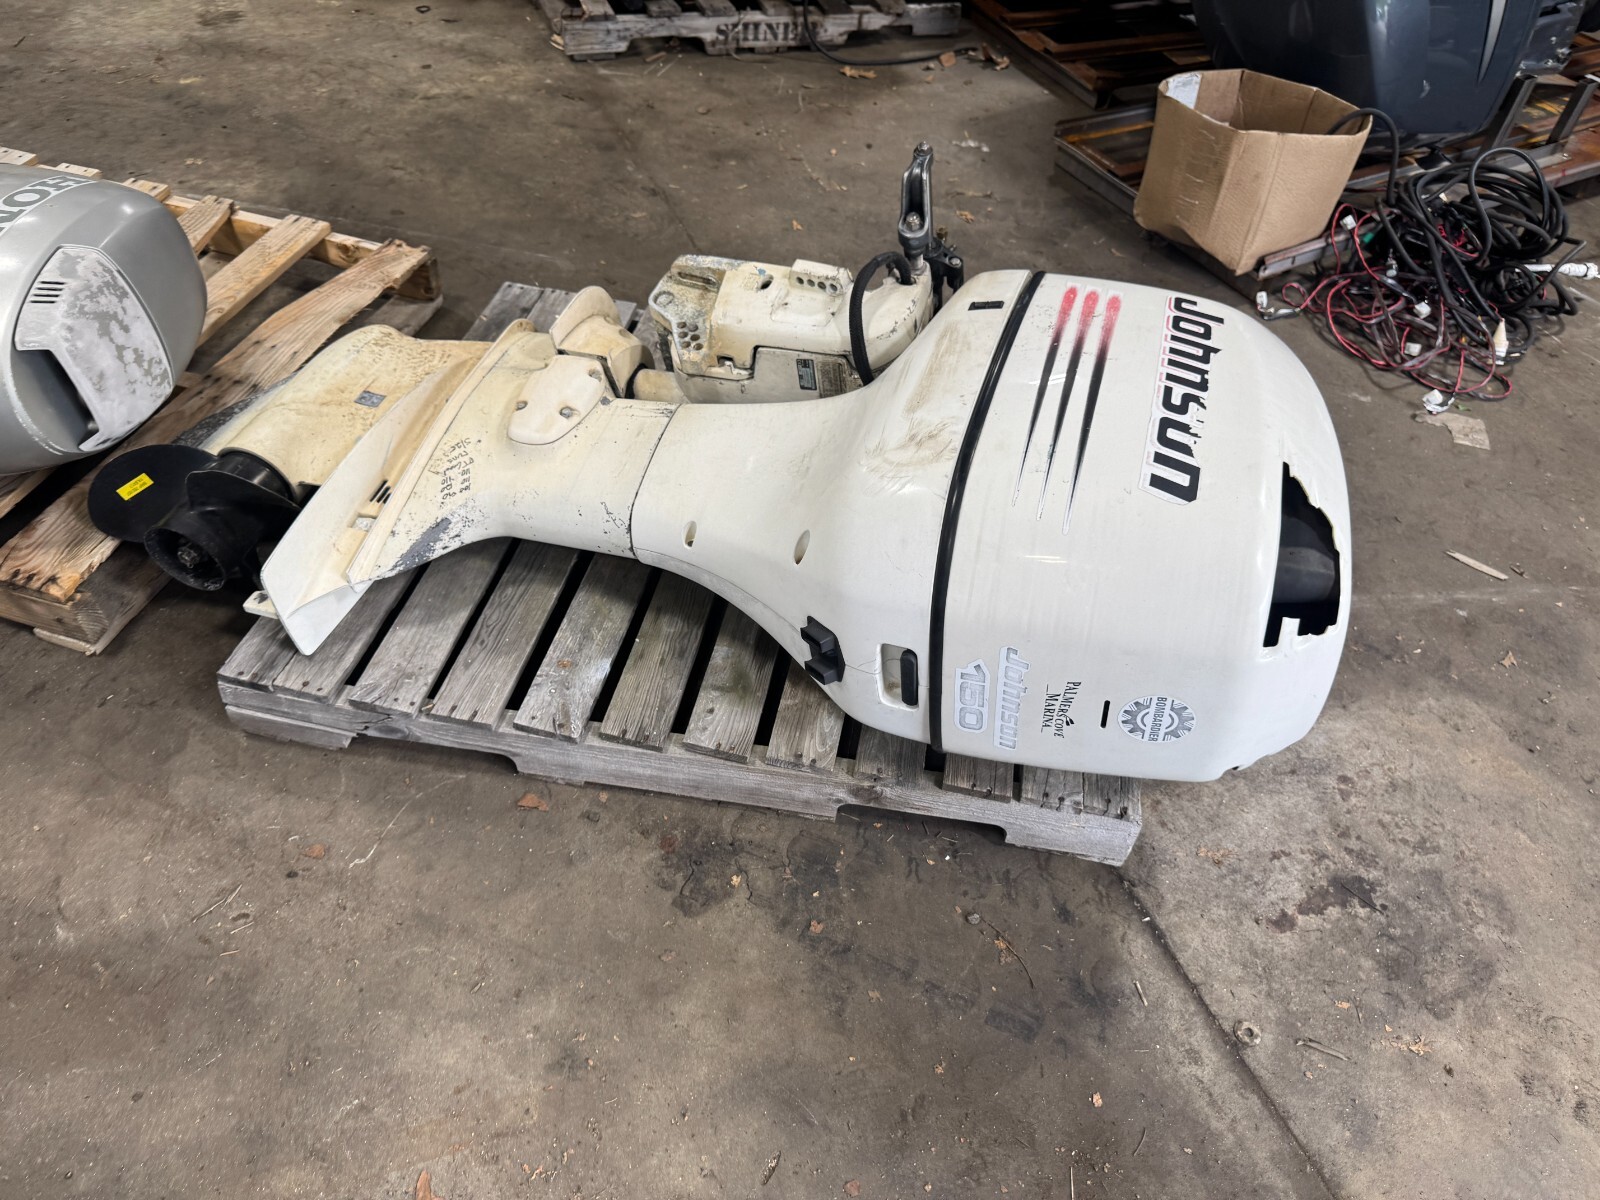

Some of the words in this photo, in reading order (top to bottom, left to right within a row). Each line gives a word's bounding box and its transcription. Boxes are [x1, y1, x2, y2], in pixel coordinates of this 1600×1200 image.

[1148, 296, 1225, 503] Johnson
[959, 663, 986, 731] 150
[998, 646, 1031, 750] Johnson
[1041, 692, 1062, 729] MARINA
[1147, 696, 1168, 742] BOMBARDIER
[1053, 717, 1065, 739] COVE
